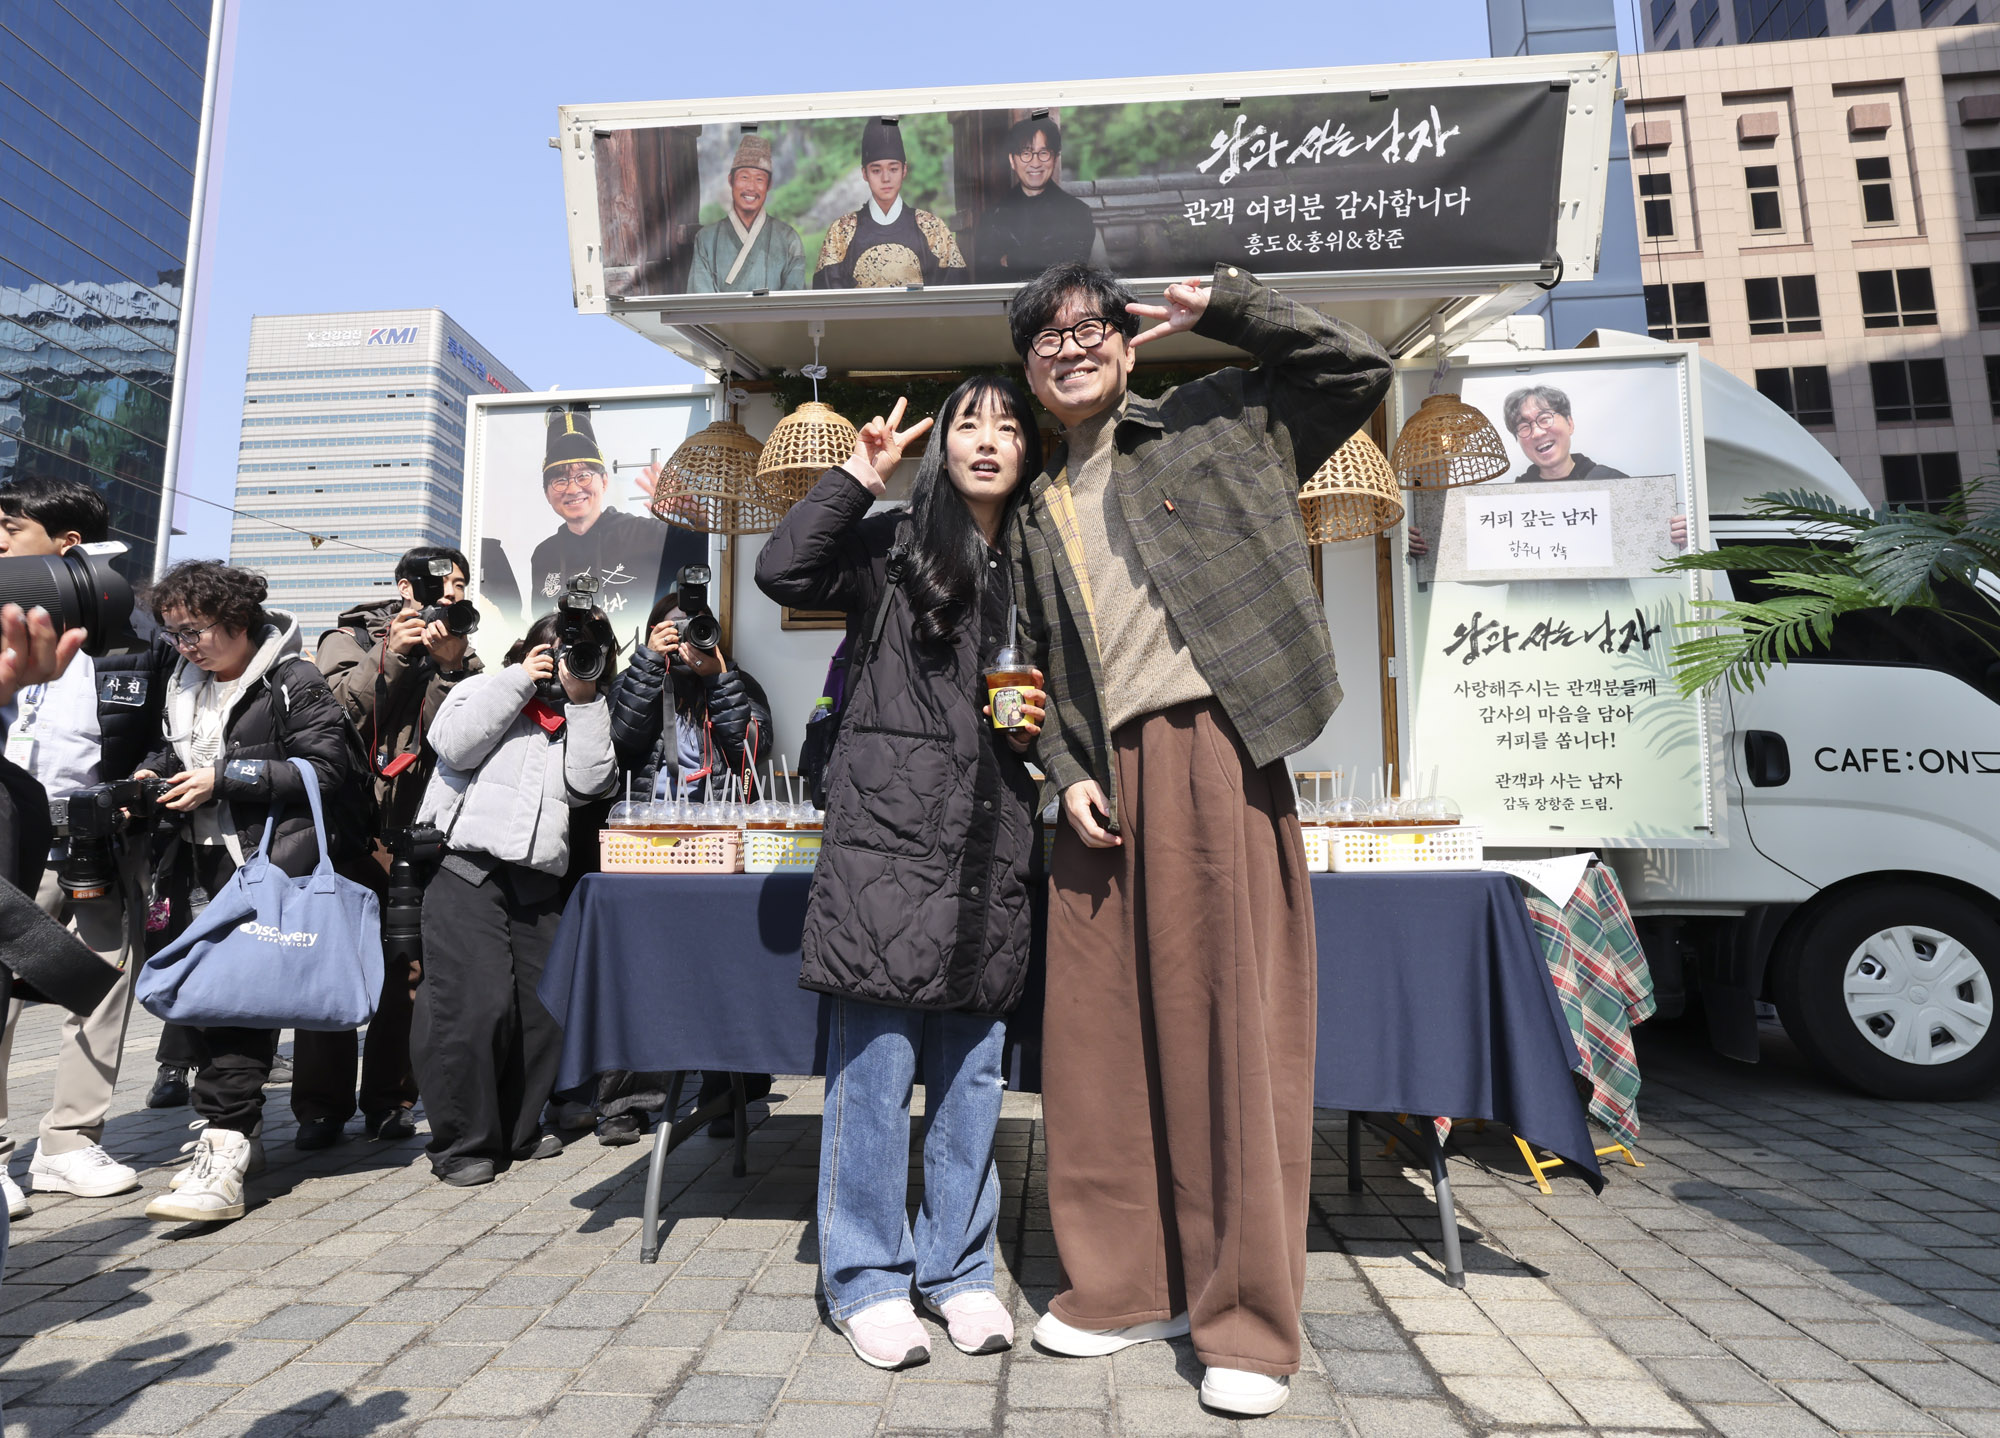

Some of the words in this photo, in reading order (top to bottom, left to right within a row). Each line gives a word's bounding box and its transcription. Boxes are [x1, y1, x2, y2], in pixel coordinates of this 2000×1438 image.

[1197, 114, 1289, 185] 왕과
[1287, 119, 1367, 164] 사는
[1365, 104, 1460, 164] 남자
[1183, 198, 1235, 226] 관객
[1246, 194, 1325, 224] 여러분
[1335, 186, 1471, 220] 감사합니다
[1244, 228, 1405, 255] 흥도&홍위&항준
[367, 327, 419, 346] KMI
[1480, 510, 1513, 528] 커피
[1562, 507, 1598, 526] 남자
[1443, 611, 1519, 665] 왕과
[1518, 617, 1584, 651] 사는
[1584, 608, 1662, 653] 남자
[1454, 680, 1560, 698] 사랑해주시는
[1566, 678, 1656, 697] 관객분들께
[1479, 705, 1531, 724] 감사의
[1538, 705, 1591, 724] 마음을
[1598, 704, 1634, 724] 담아
[1496, 731, 1549, 749] 커피를
[1555, 731, 1616, 750] 쏩니다!
[1814, 747, 1969, 774] CAFE:ON
[743, 768, 752, 795] Canon
[1495, 772, 1545, 790] 관객과
[1550, 772, 1582, 790] 사는
[1588, 772, 1623, 790] 남자
[1503, 796, 1530, 811] 감독
[1534, 796, 1575, 811] 장항준
[1580, 796, 1613, 811] 드림.
[240, 921, 318, 947] Discovery
